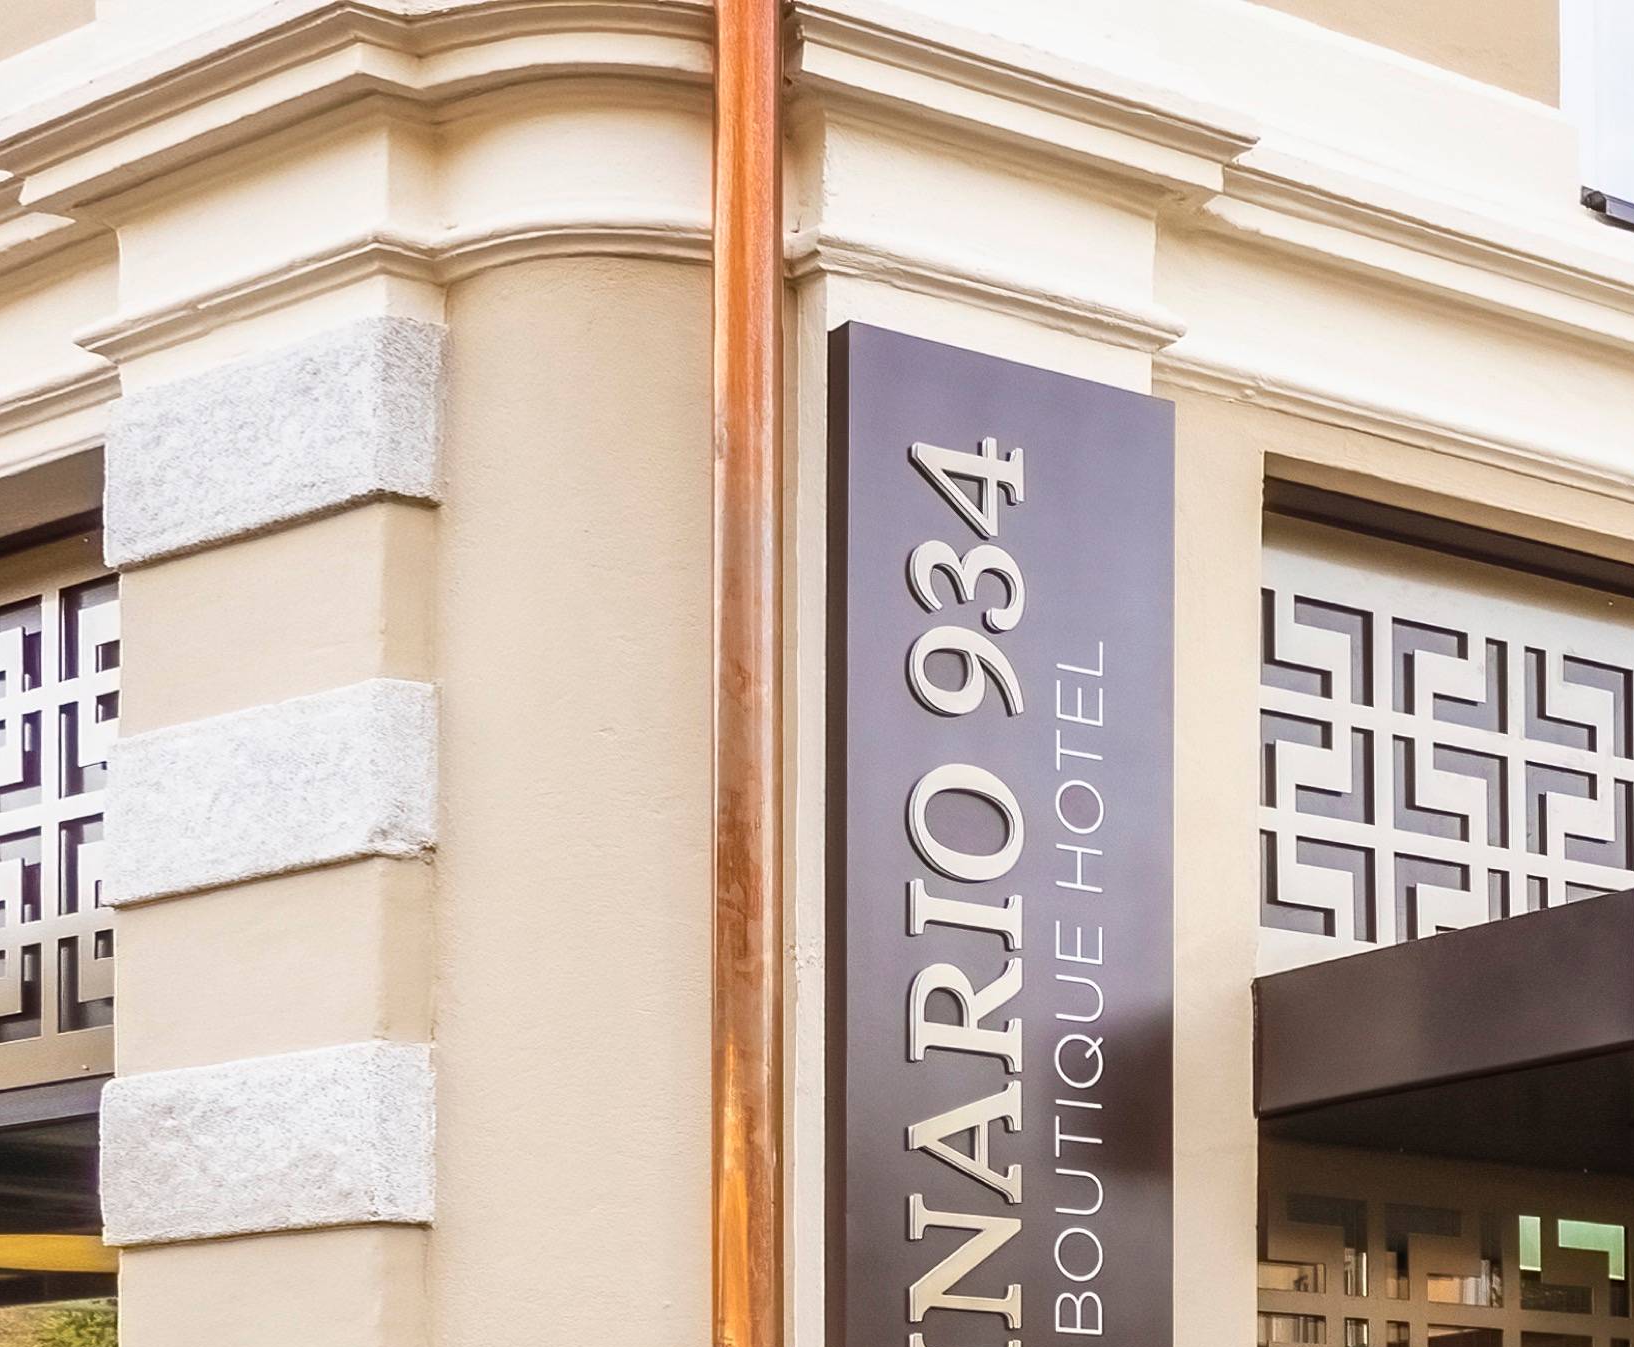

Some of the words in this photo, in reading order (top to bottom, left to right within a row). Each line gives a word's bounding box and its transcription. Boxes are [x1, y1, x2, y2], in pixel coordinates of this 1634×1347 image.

[908, 435, 1026, 716] 934
[1053, 639, 1105, 894] HOTEL
[1053, 919, 1105, 1335] BOUTIQUE
